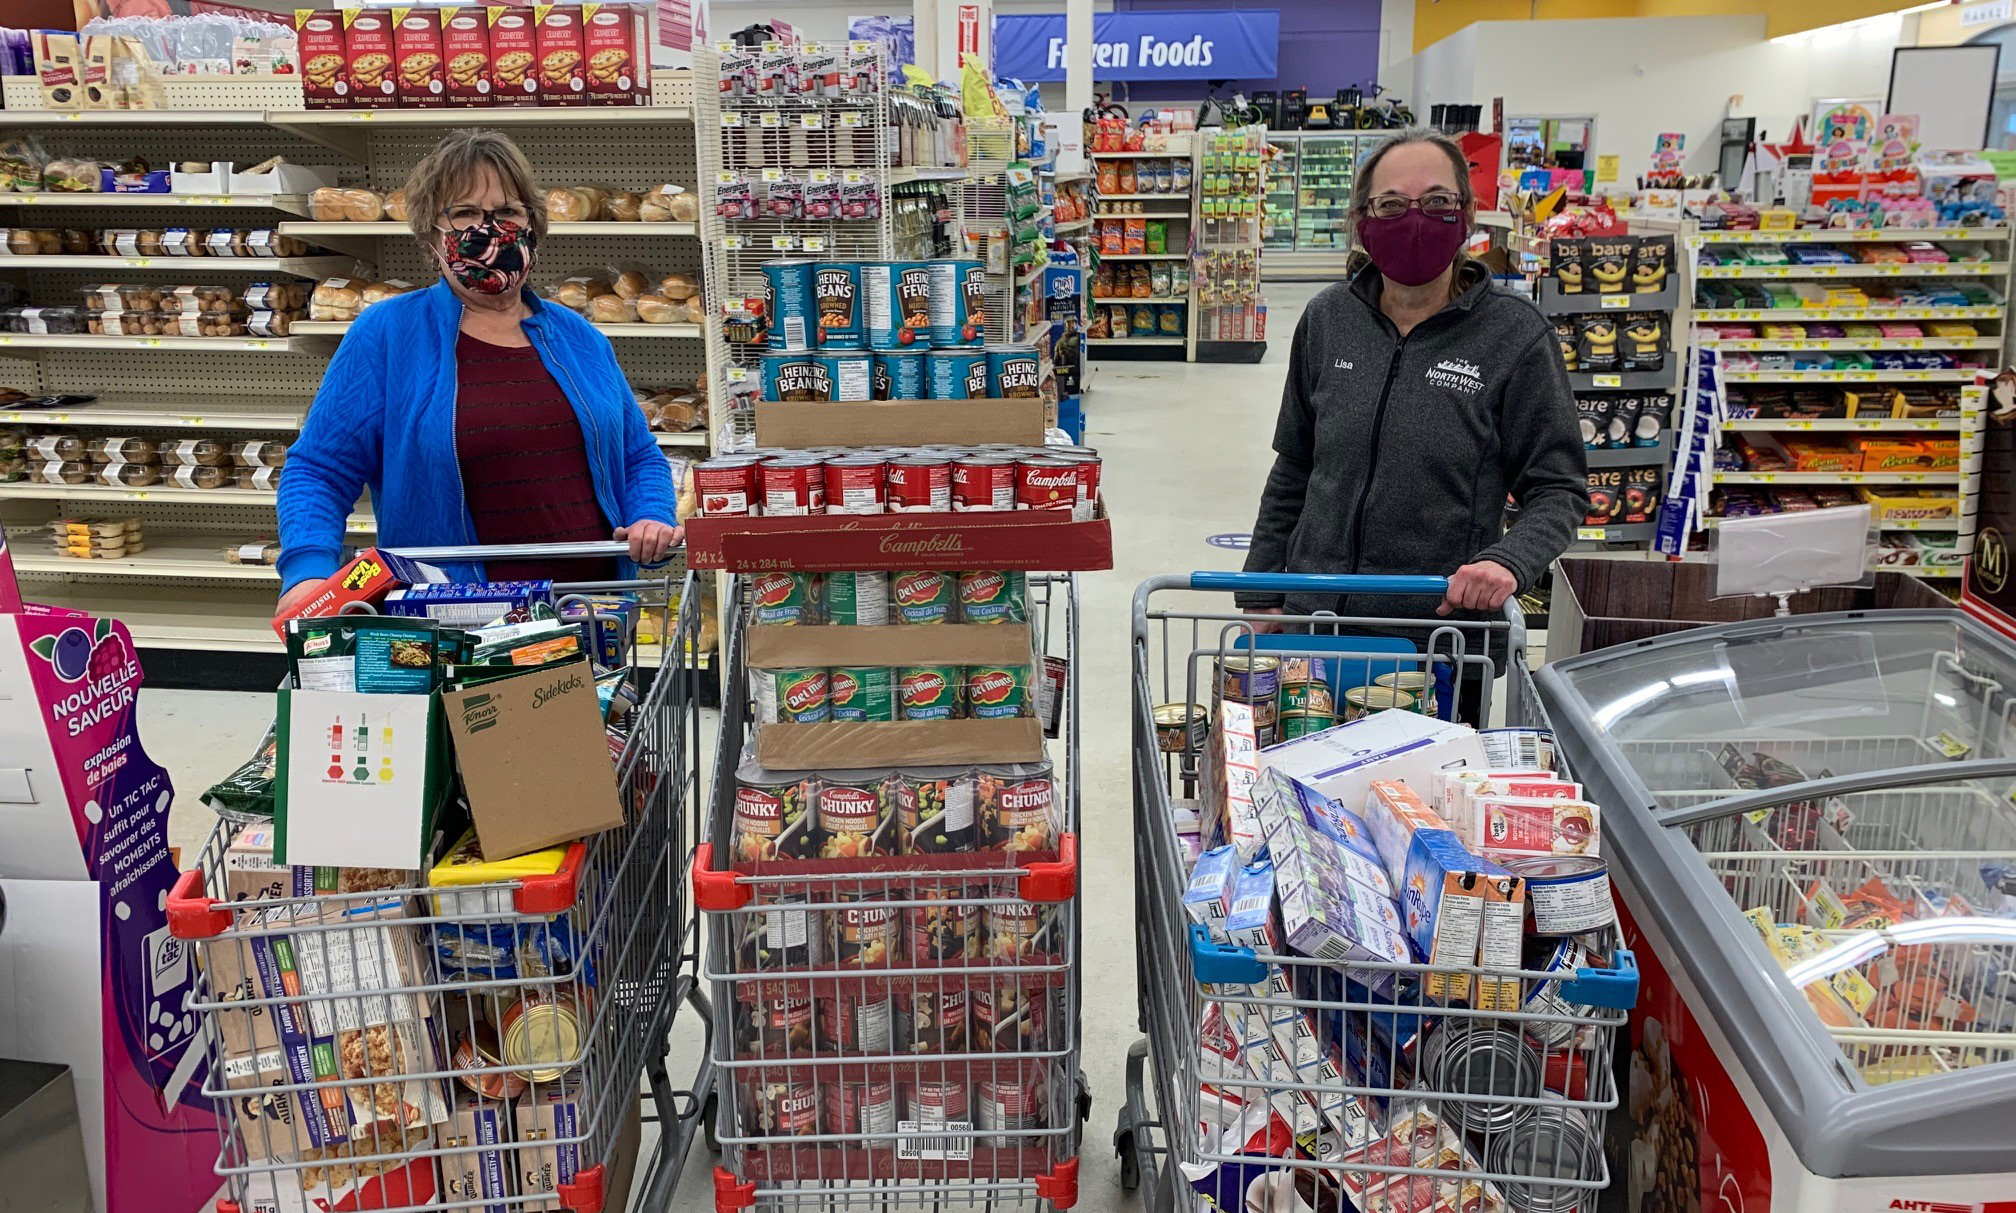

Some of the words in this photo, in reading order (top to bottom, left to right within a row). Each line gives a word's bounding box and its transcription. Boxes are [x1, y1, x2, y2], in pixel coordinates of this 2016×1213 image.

[961, 11, 976, 20] FIRE
[355, 34, 380, 42] CRANBERRY
[452, 33, 476, 41] CRANBERRY
[500, 31, 524, 39] CRANBERRY
[546, 30, 571, 38] CRANBERRY
[594, 29, 619, 37] CRANBERRY
[1047, 37, 1129, 69] Frzen
[1138, 34, 1214, 67] Foods
[721, 56, 753, 72] Energizer
[762, 54, 795, 70] Energizer
[802, 56, 835, 72] Energizer
[717, 182, 750, 196] Energizer
[806, 182, 840, 196] Energizer
[843, 182, 876, 195] Energizer
[1591, 241, 1632, 257] bare
[1637, 243, 1666, 257] are
[818, 273, 848, 285] HEINZ
[816, 284, 852, 298] BEANS
[1008, 362, 1036, 375] HEINZ
[1334, 358, 1354, 370] Lisa
[1002, 374, 1038, 388] BEANS
[1430, 378, 1476, 396] COMPANY
[736, 560, 749, 569] 24
[751, 561, 756, 569] x
[759, 558, 778, 569] 284
[780, 558, 795, 568] mL
[341, 558, 373, 590] Value
[358, 562, 382, 590] Best
[765, 576, 792, 592] Monte
[897, 583, 914, 600] Del
[914, 575, 942, 591] Monte
[960, 584, 974, 598] Del
[974, 575, 1002, 589] Monte
[904, 608, 925, 617] Cocktail
[967, 607, 980, 615] Fruit
[981, 606, 1006, 615] Cocktail
[305, 638, 330, 651] Knorr
[53, 660, 138, 721] NOUVELLE
[532, 673, 582, 709] Sidekicks
[902, 685, 916, 700] Del
[916, 676, 942, 691] Monte
[970, 684, 984, 698] Del
[984, 676, 1012, 690] Monte
[788, 690, 810, 708] Del
[68, 686, 134, 737] SAVEUR
[462, 704, 498, 725] Knorr
[838, 710, 860, 718] Cocktail
[906, 709, 926, 717] Cocktail
[976, 707, 995, 716] Cocktail
[1003, 706, 1018, 714] Fruits
[84, 734, 131, 771] explosion
[87, 768, 100, 786] de
[101, 752, 128, 778] baies
[109, 805, 123, 819] Un
[124, 790, 139, 809] TIC
[738, 800, 778, 816] HUNKY
[820, 796, 874, 814] CHUNKY
[104, 820, 128, 843] suffit
[129, 803, 150, 827] pour
[98, 831, 139, 866] savourer
[140, 818, 156, 835] des
[114, 832, 161, 875] MOMENTS
[165, 937, 180, 952] tic
[162, 948, 179, 965] tac
[279, 1004, 294, 1034] FLAVOUR
[543, 1162, 552, 1191] QUAKER
[468, 1171, 478, 1199] QUAKER
[1889, 1199, 1931, 1212] AHT
